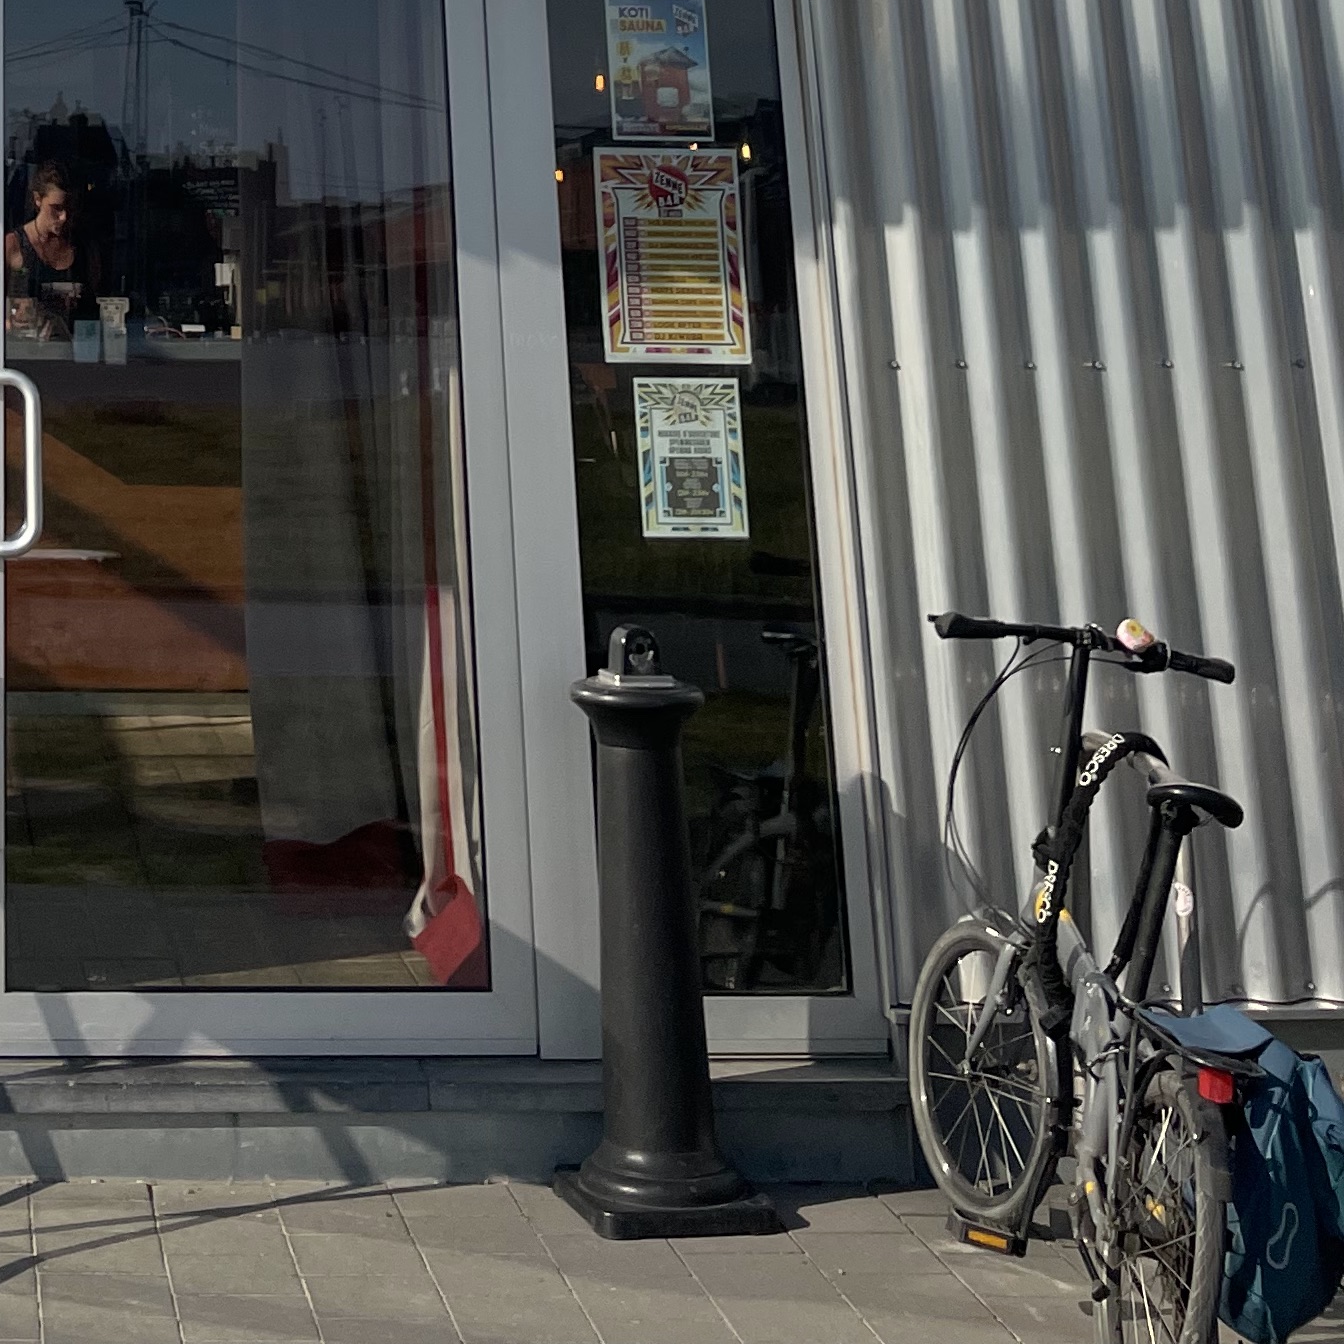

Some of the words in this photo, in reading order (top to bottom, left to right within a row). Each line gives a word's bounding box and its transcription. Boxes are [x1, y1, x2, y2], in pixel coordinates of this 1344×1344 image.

[618, 7, 649, 19] KOTI
[619, 20, 665, 32] SAUNA
[654, 171, 683, 194] ZENNE
[1079, 732, 1125, 787] DRESCO
